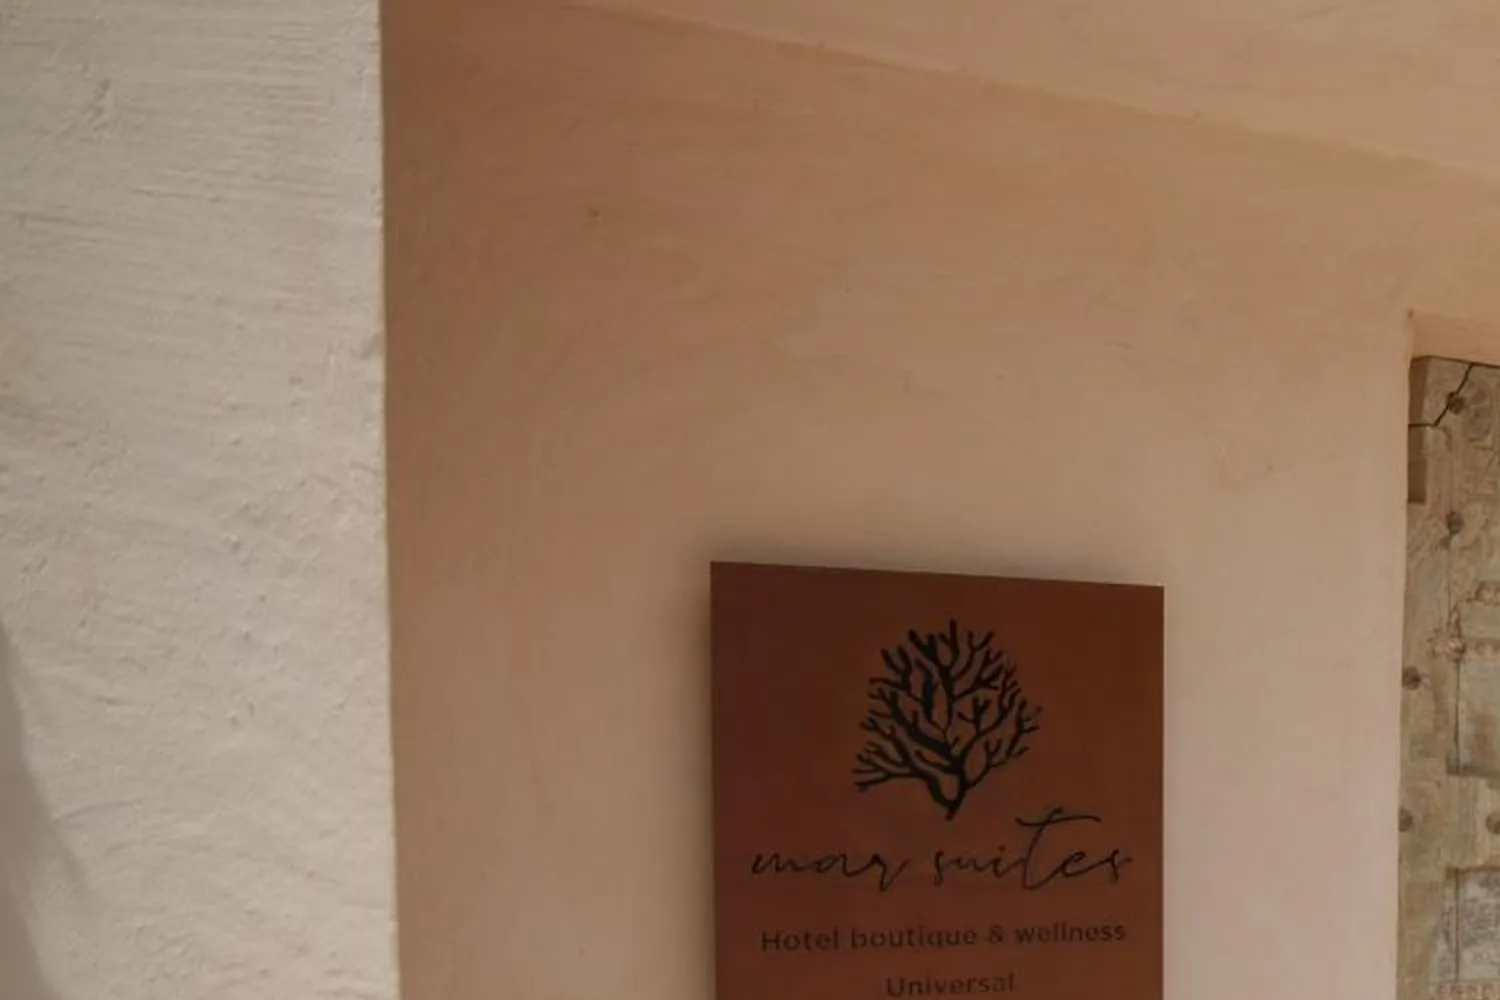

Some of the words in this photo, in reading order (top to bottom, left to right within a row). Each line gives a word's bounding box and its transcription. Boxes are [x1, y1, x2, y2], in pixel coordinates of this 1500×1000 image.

[751, 848, 911, 893] mar
[932, 806, 1133, 891] suites
[760, 927, 840, 952] Hotel
[850, 923, 978, 951] boutique
[987, 924, 1006, 945] &
[1013, 920, 1127, 944] wellness
[885, 972, 1015, 999] Universal
